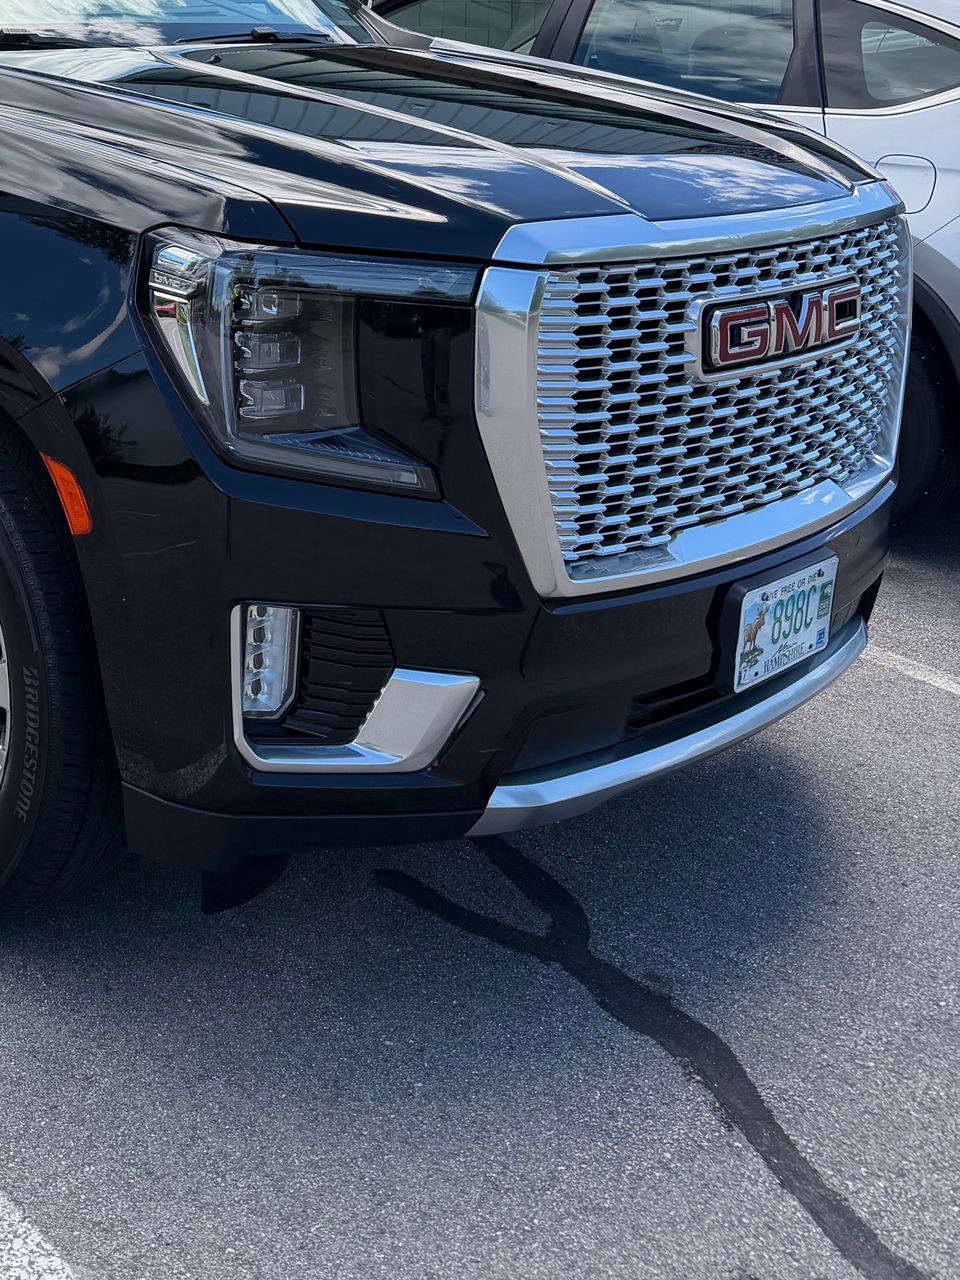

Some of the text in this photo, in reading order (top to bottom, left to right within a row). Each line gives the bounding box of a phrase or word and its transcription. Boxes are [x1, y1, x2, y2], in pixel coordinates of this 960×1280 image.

[154, 272, 181, 288] GMC
[710, 283, 861, 367] GMC
[781, 582, 795, 596] FREE
[797, 577, 806, 589] OR
[771, 584, 817, 645] 898C
[763, 641, 805, 673] HAMPSHIRE
[13, 665, 41, 825] BRIDGESTONE
